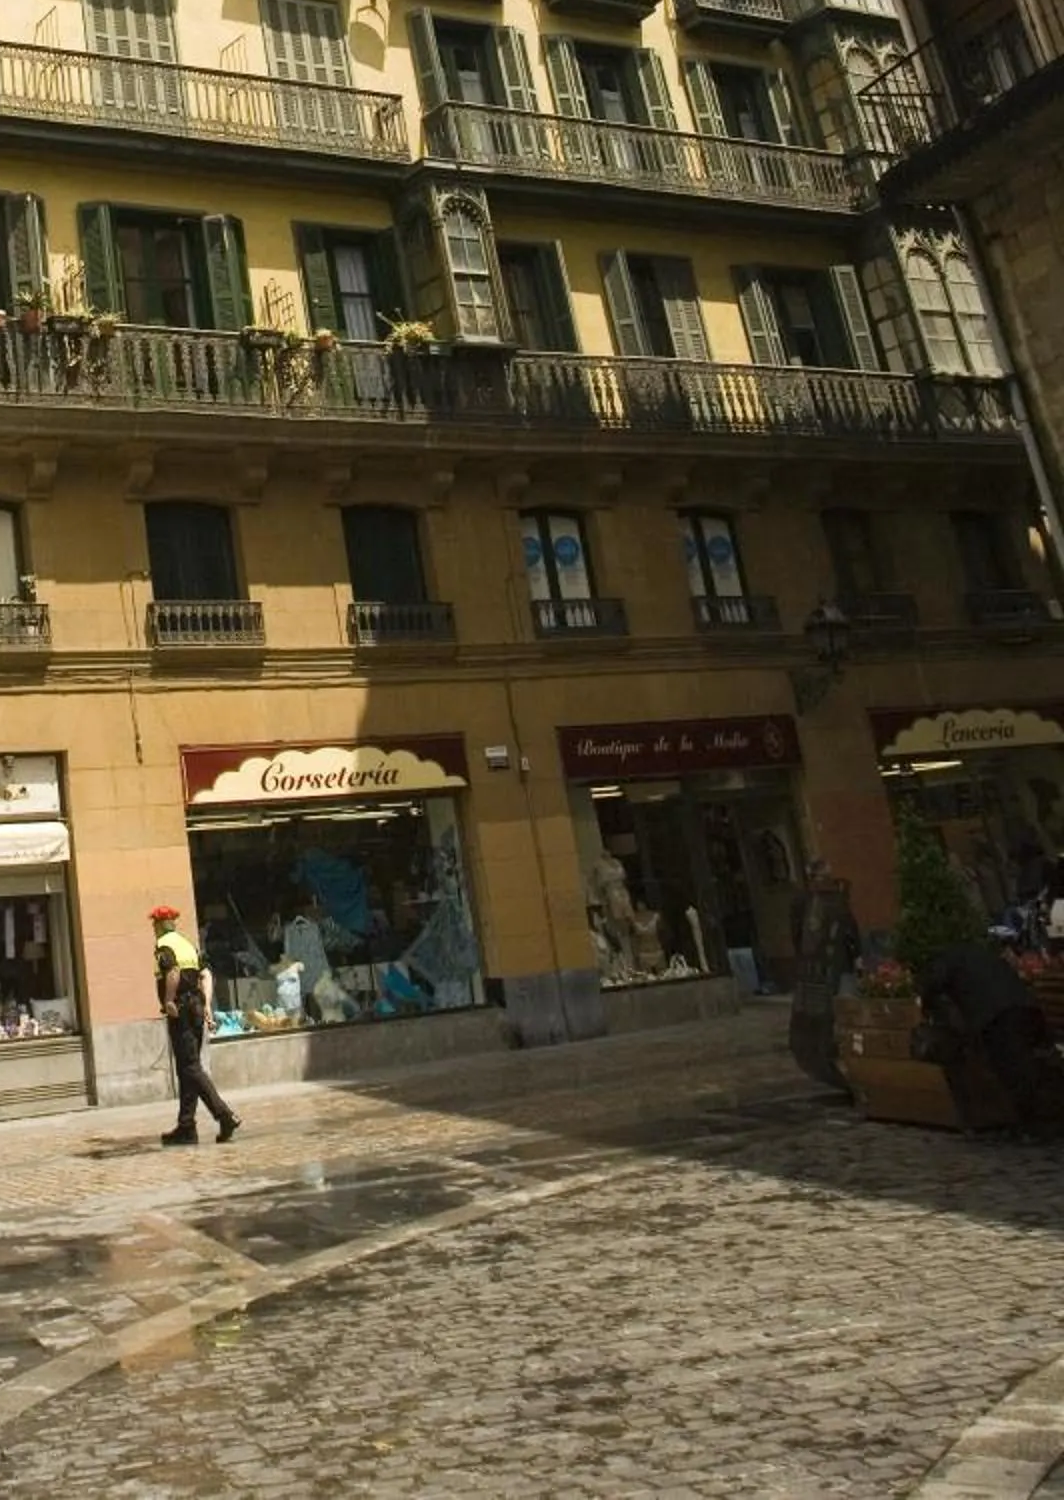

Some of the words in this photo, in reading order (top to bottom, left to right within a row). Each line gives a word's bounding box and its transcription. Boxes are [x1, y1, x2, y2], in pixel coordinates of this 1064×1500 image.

[653, 734, 670, 752] de
[679, 732, 694, 751] la
[260, 761, 399, 792] Corsetería
